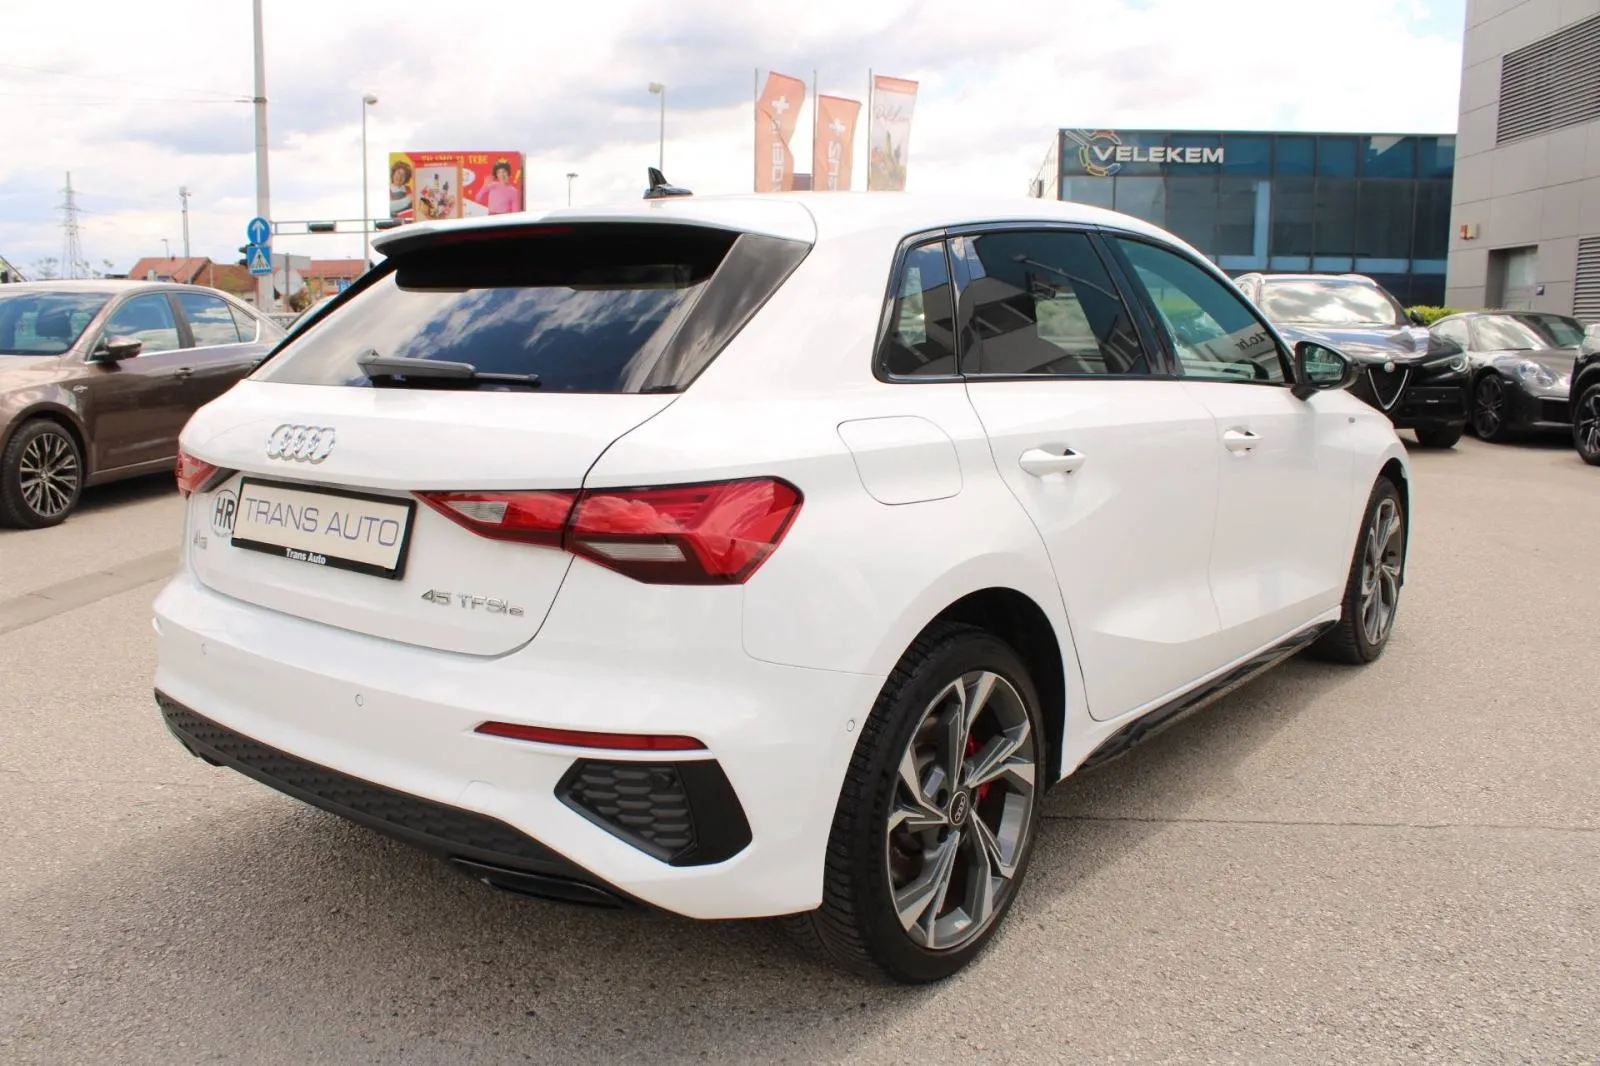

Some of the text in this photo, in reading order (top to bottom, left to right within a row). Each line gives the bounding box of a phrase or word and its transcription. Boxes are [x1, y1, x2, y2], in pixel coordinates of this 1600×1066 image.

[1092, 145, 1224, 164] VELEKEM
[214, 496, 235, 529] HR
[245, 497, 400, 547] TRANS AUTO
[286, 547, 326, 565] Trans Auto
[421, 589, 452, 606] 45
